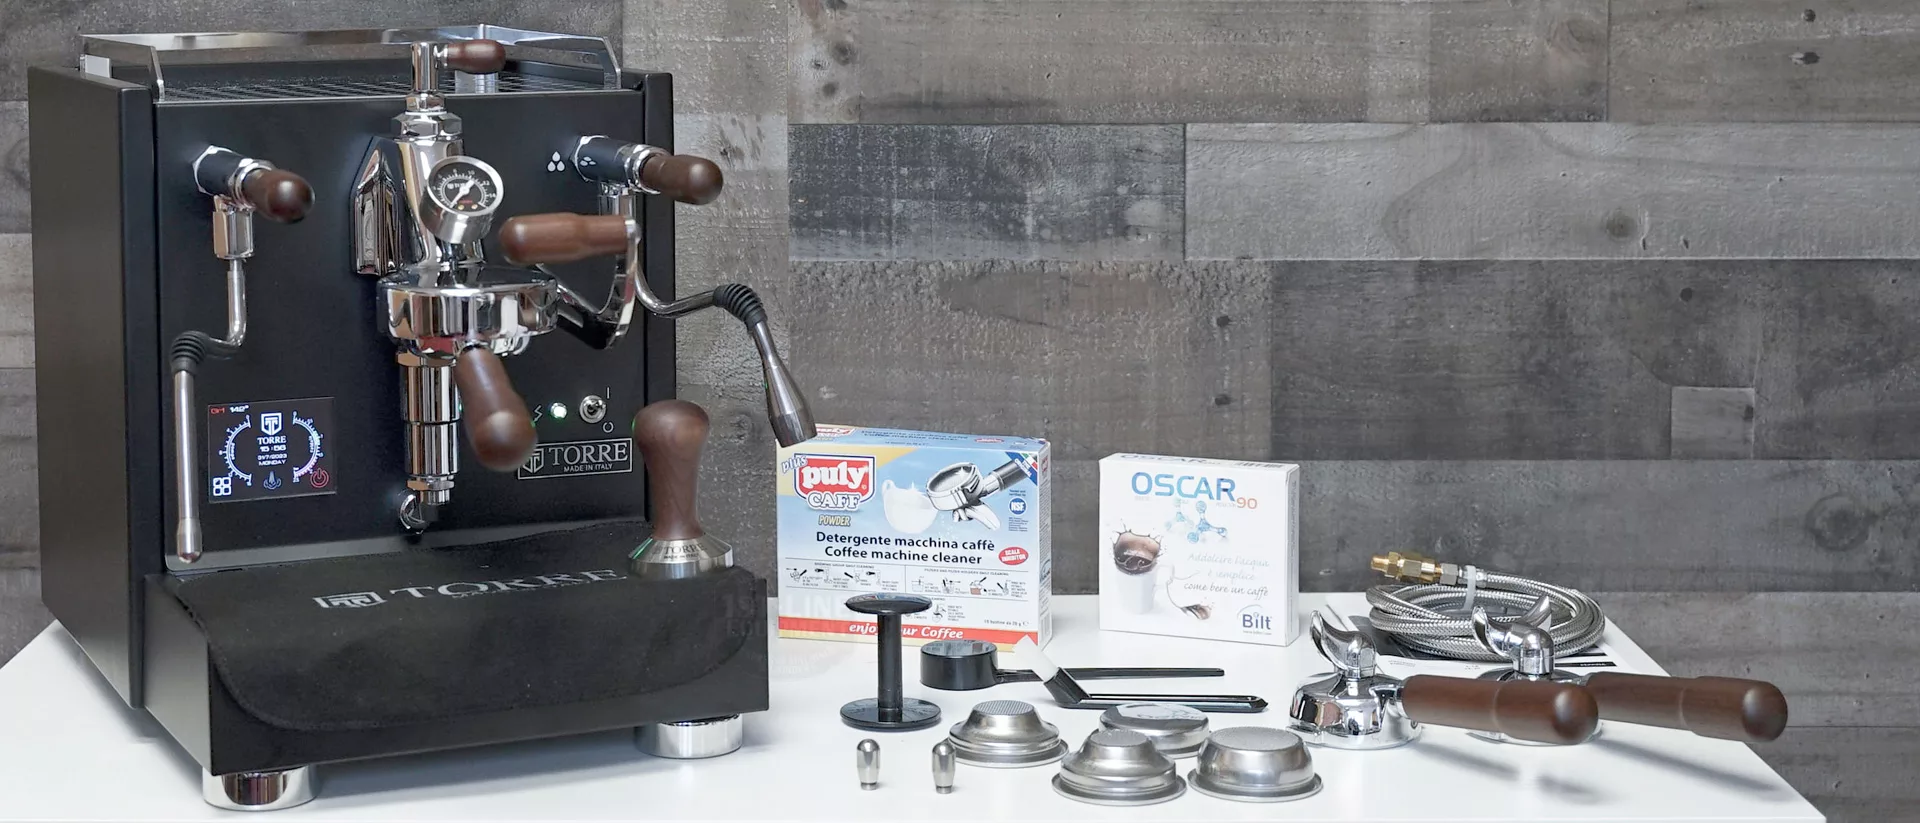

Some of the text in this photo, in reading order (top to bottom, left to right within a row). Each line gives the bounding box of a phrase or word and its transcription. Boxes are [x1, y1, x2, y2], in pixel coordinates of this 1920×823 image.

[257, 435, 287, 445] TORRE
[549, 442, 628, 466] TORRE
[594, 463, 613, 471] ITALY
[782, 456, 808, 474] plus
[801, 461, 869, 489] puly
[1131, 472, 1257, 509] OSCAR 90
[808, 492, 861, 509] CAFF
[818, 515, 851, 526] POWDER
[816, 531, 995, 551] Detergente macchina caffè
[825, 546, 982, 564] Coffee machine cleaner
[1187, 553, 1233, 565] Addolcire
[1216, 570, 1255, 584] semplice
[1184, 583, 1208, 591] come
[1209, 582, 1230, 593] bere
[1247, 586, 1269, 600] caffè
[1242, 613, 1271, 630] Bilt
[849, 623, 879, 635] enjo
[921, 627, 964, 639] Coffee
